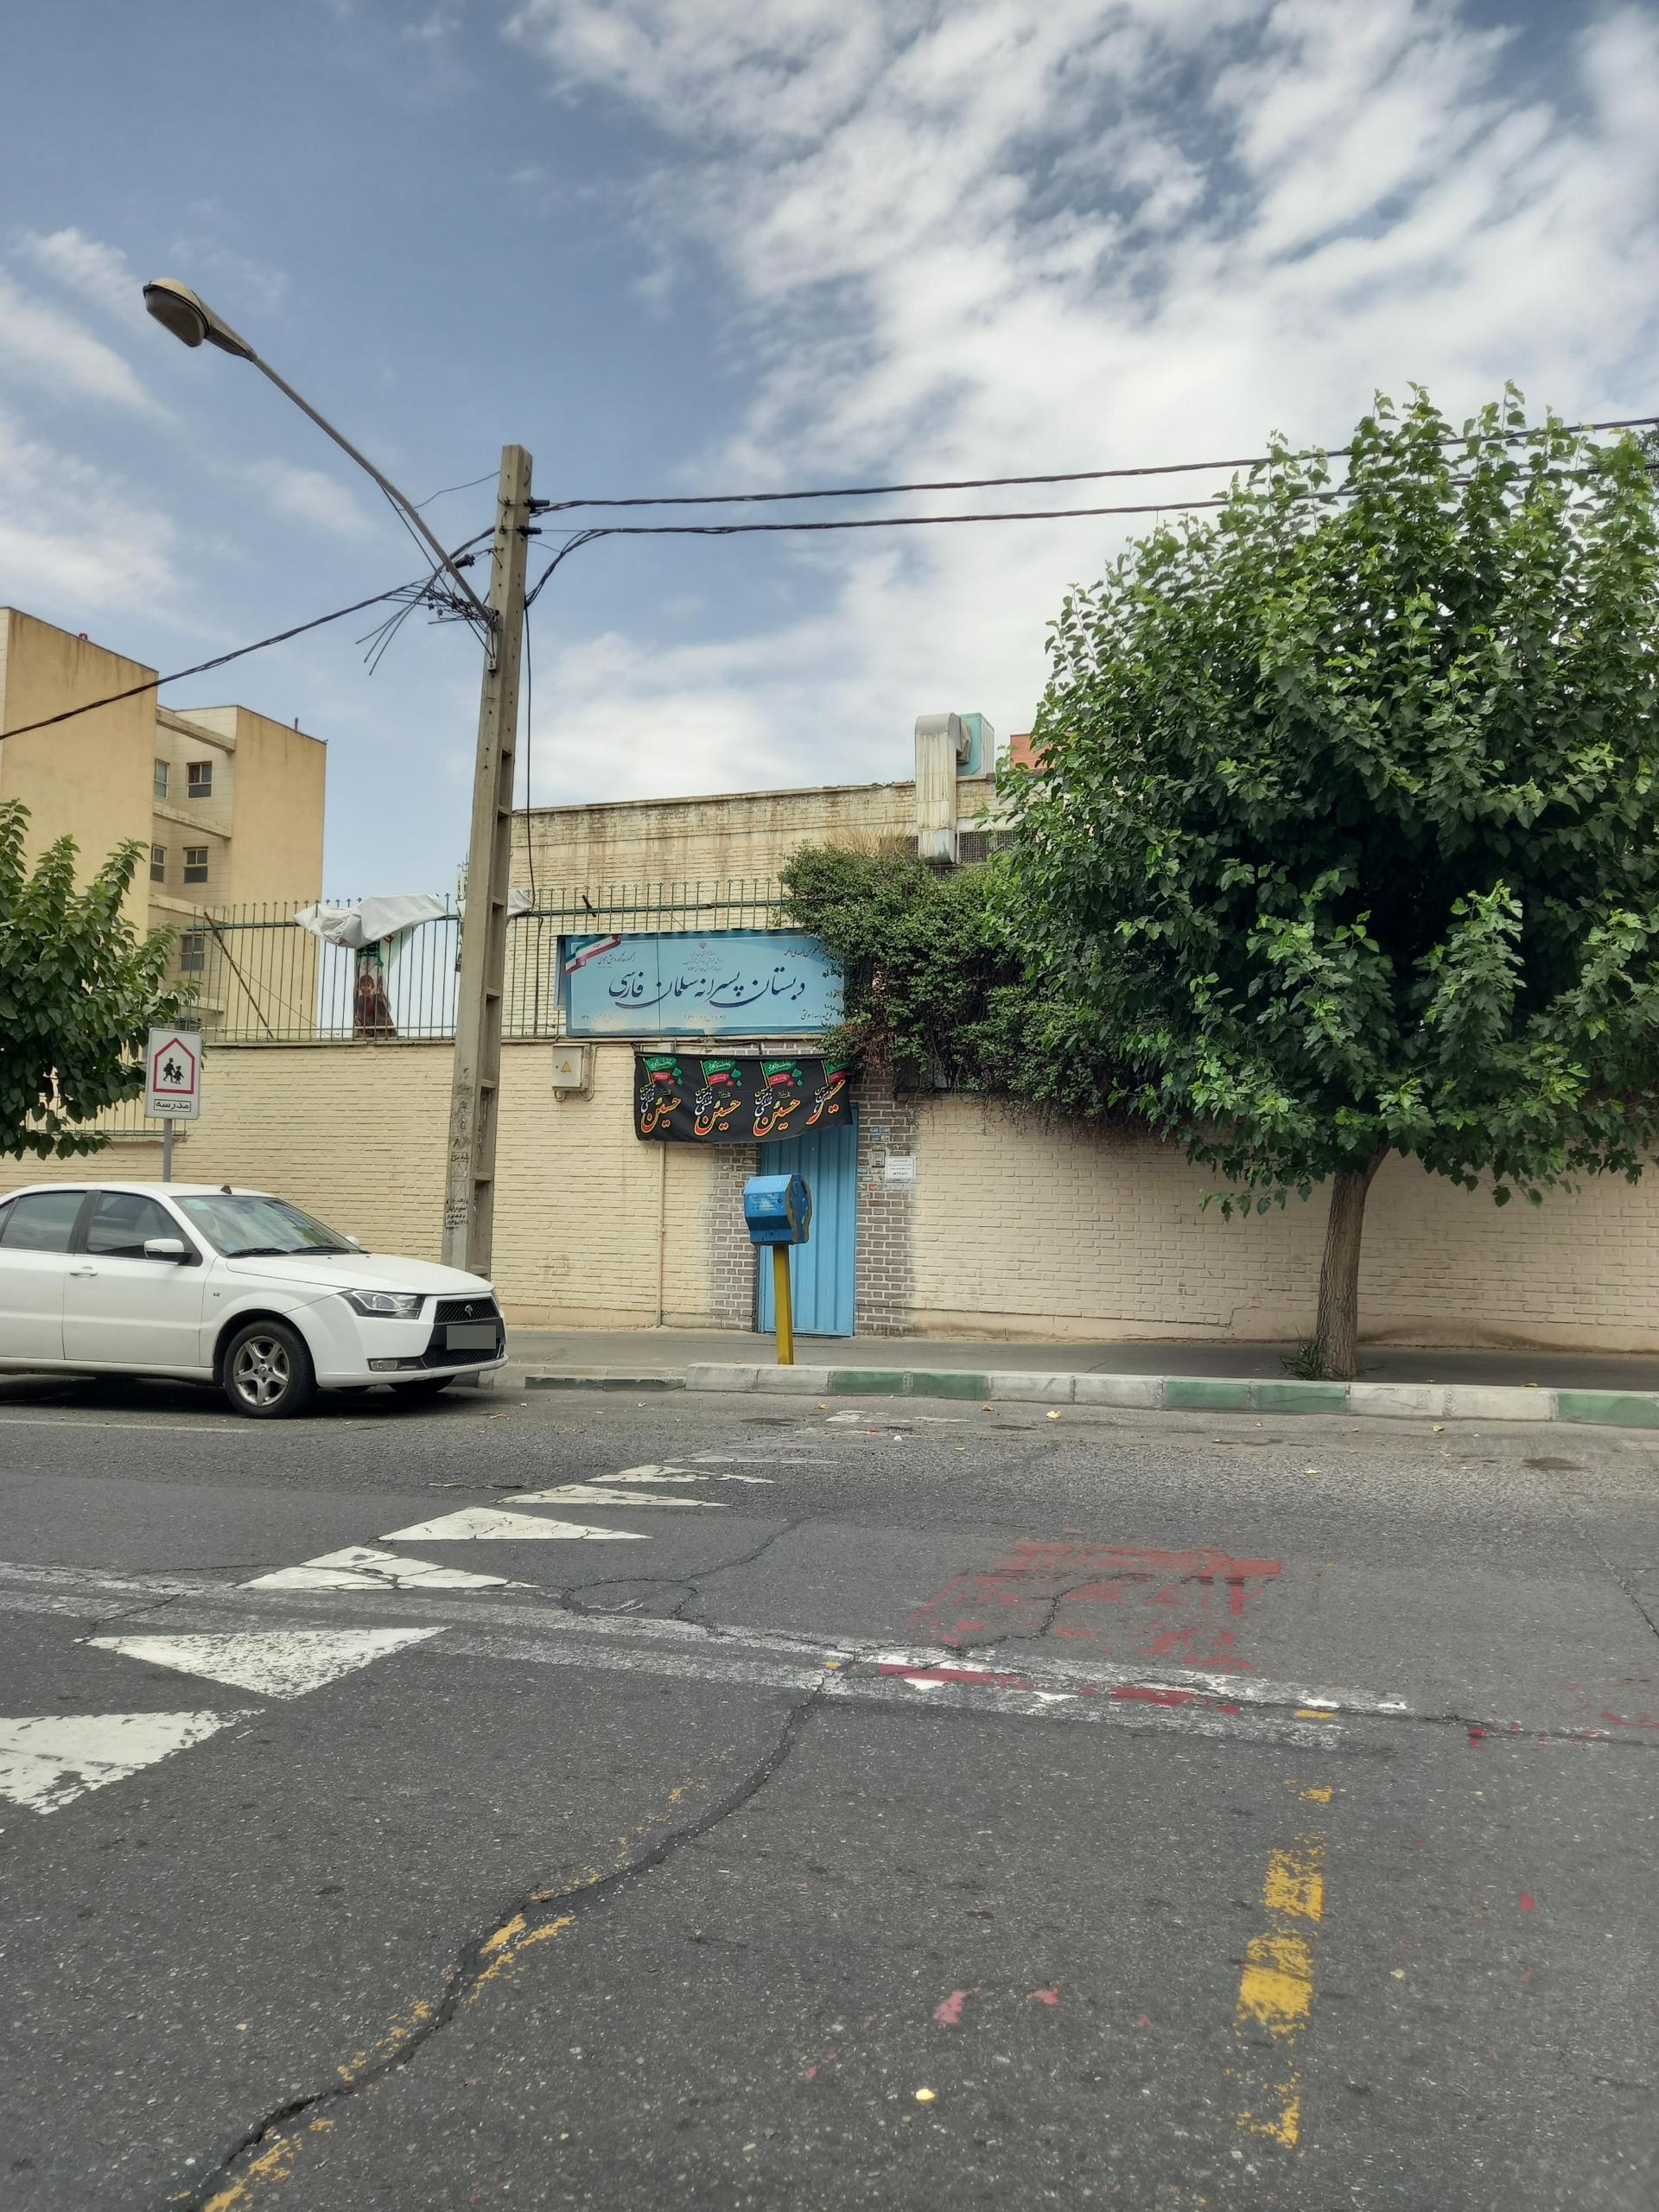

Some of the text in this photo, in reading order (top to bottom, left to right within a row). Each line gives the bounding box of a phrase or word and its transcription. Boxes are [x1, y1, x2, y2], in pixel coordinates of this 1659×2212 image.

[608, 966, 805, 1009] دبستان پسرانه سلمان فارسی
[156, 1101, 189, 1110] مدرسه
[641, 1097, 681, 1133] حسین
[694, 1100, 741, 1135] حسین
[753, 1099, 801, 1137] حسین
